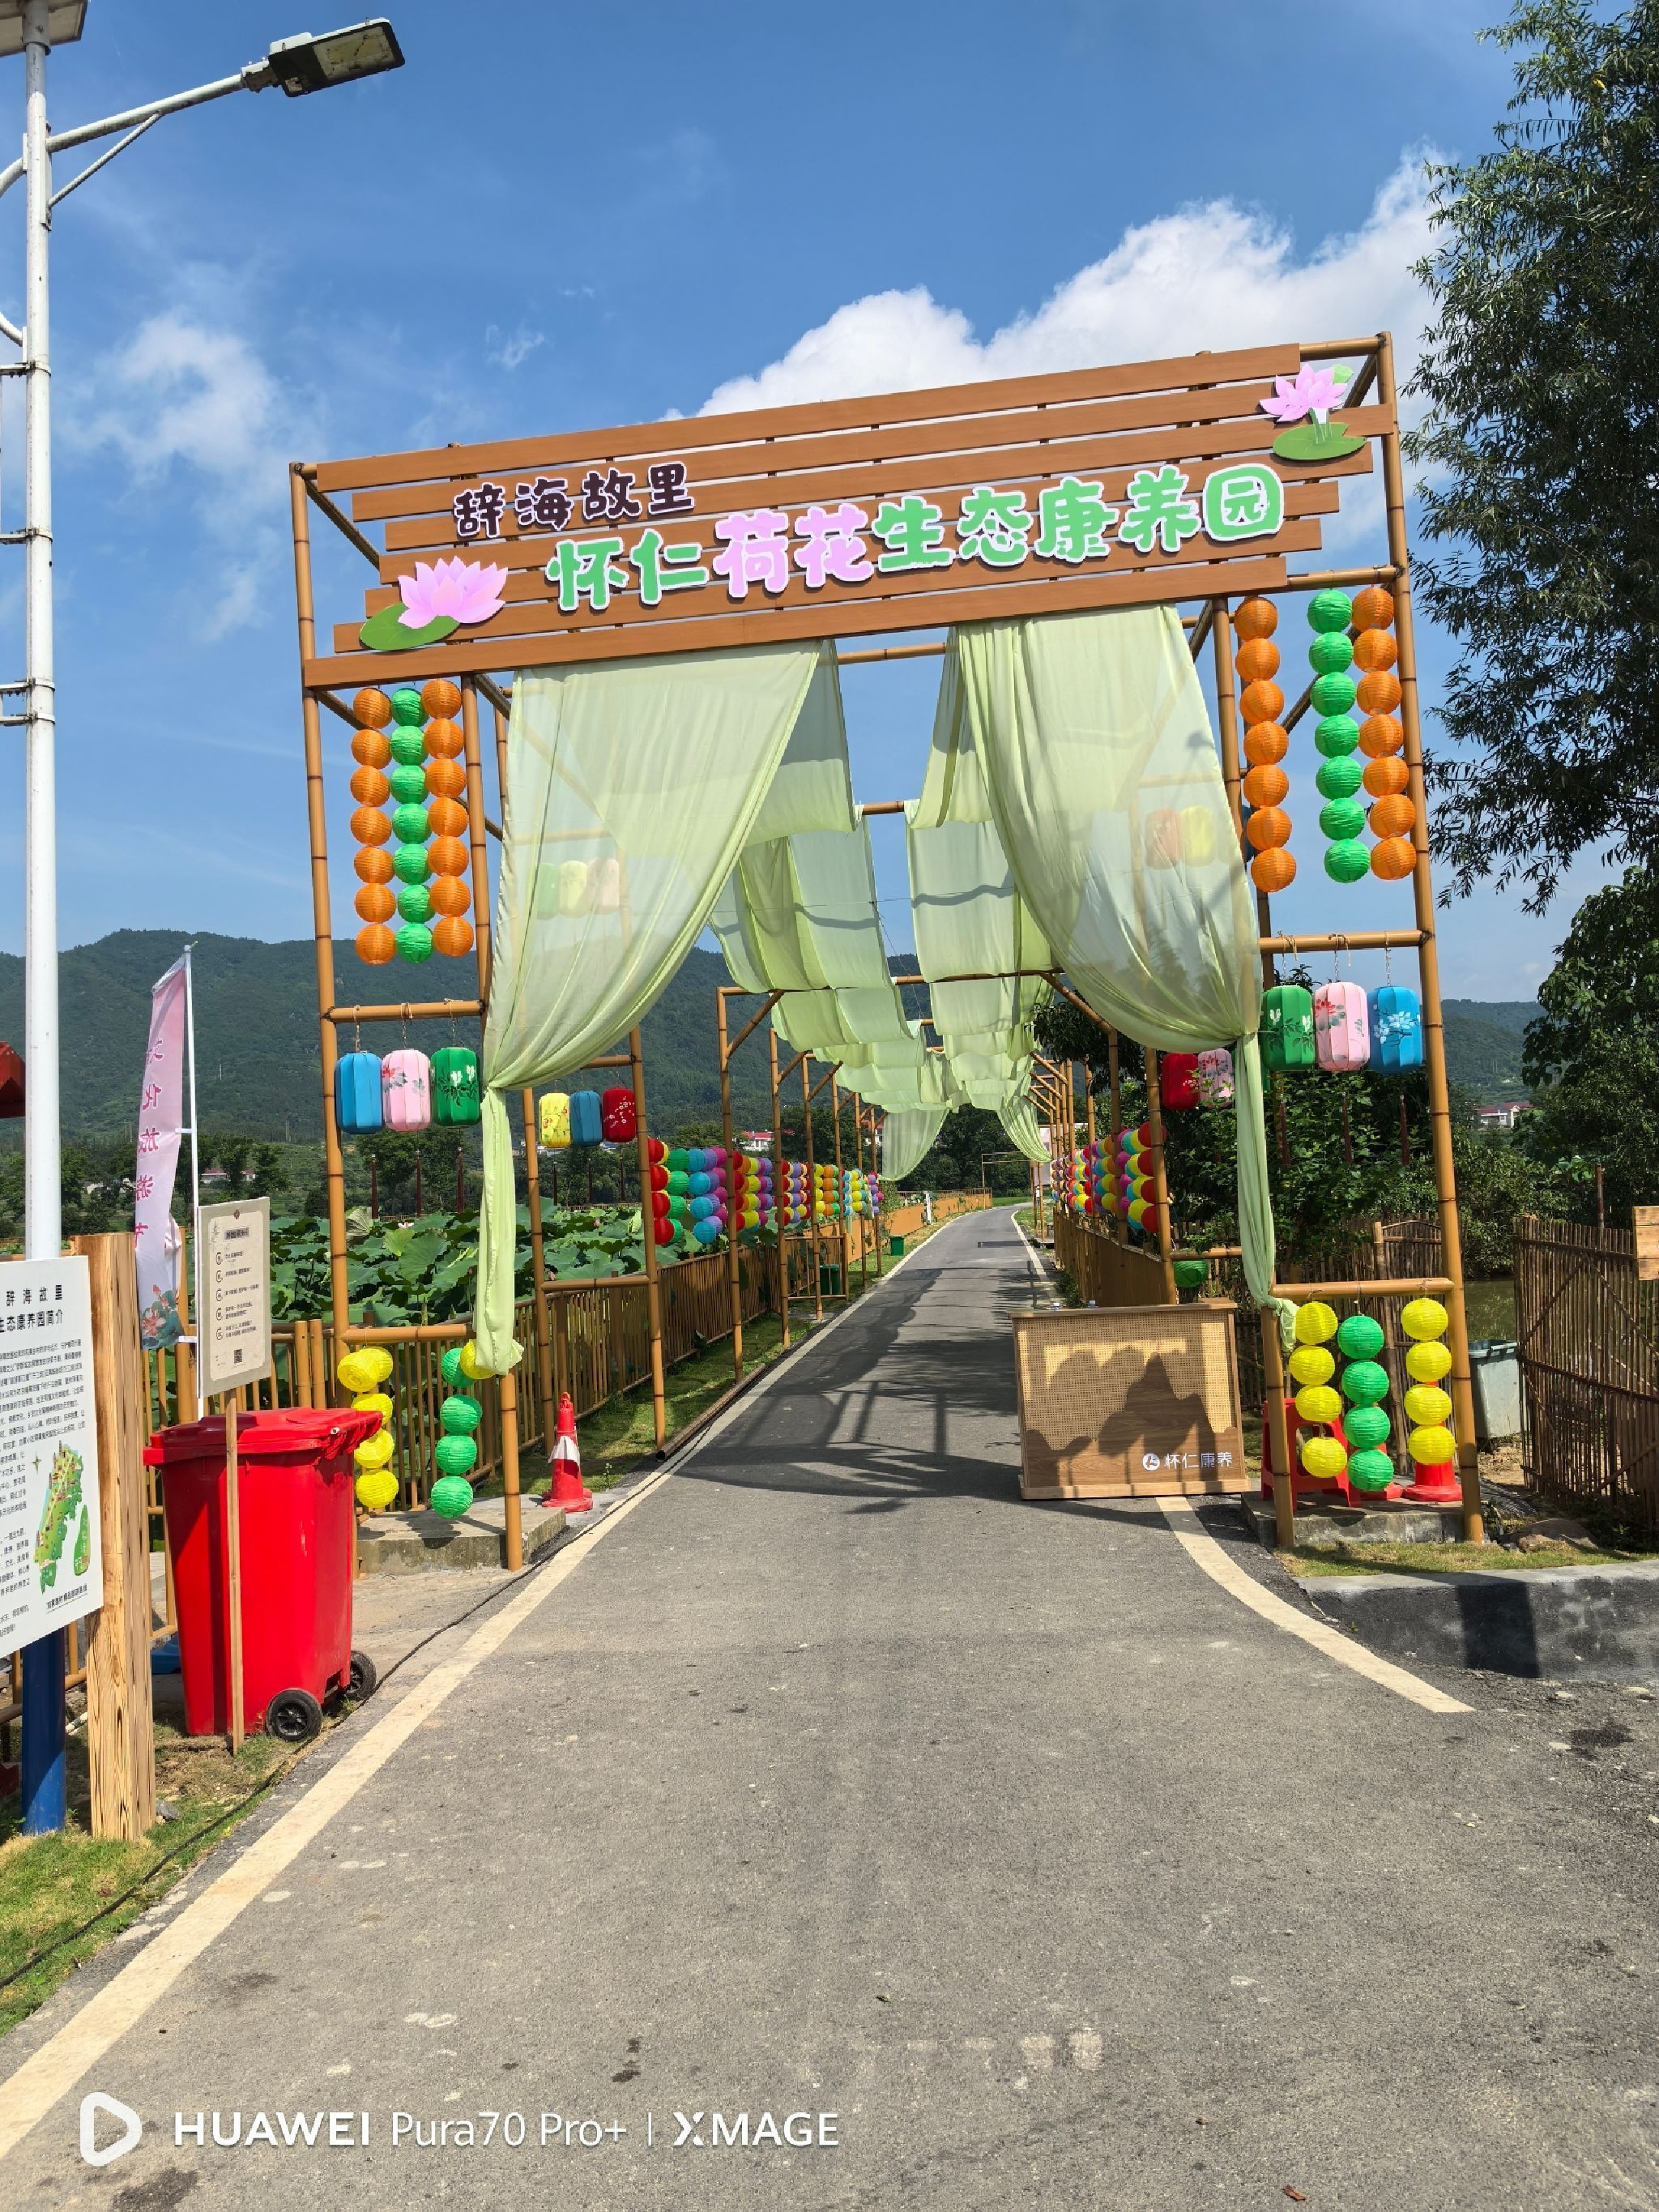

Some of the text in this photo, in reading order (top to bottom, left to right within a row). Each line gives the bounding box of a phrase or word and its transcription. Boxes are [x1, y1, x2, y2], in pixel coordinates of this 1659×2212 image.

[454, 460, 694, 538] 辞海故里
[544, 462, 1285, 610] 怀仁荷花生态康养园
[1164, 1452, 1232, 1470] 怀仁康养
